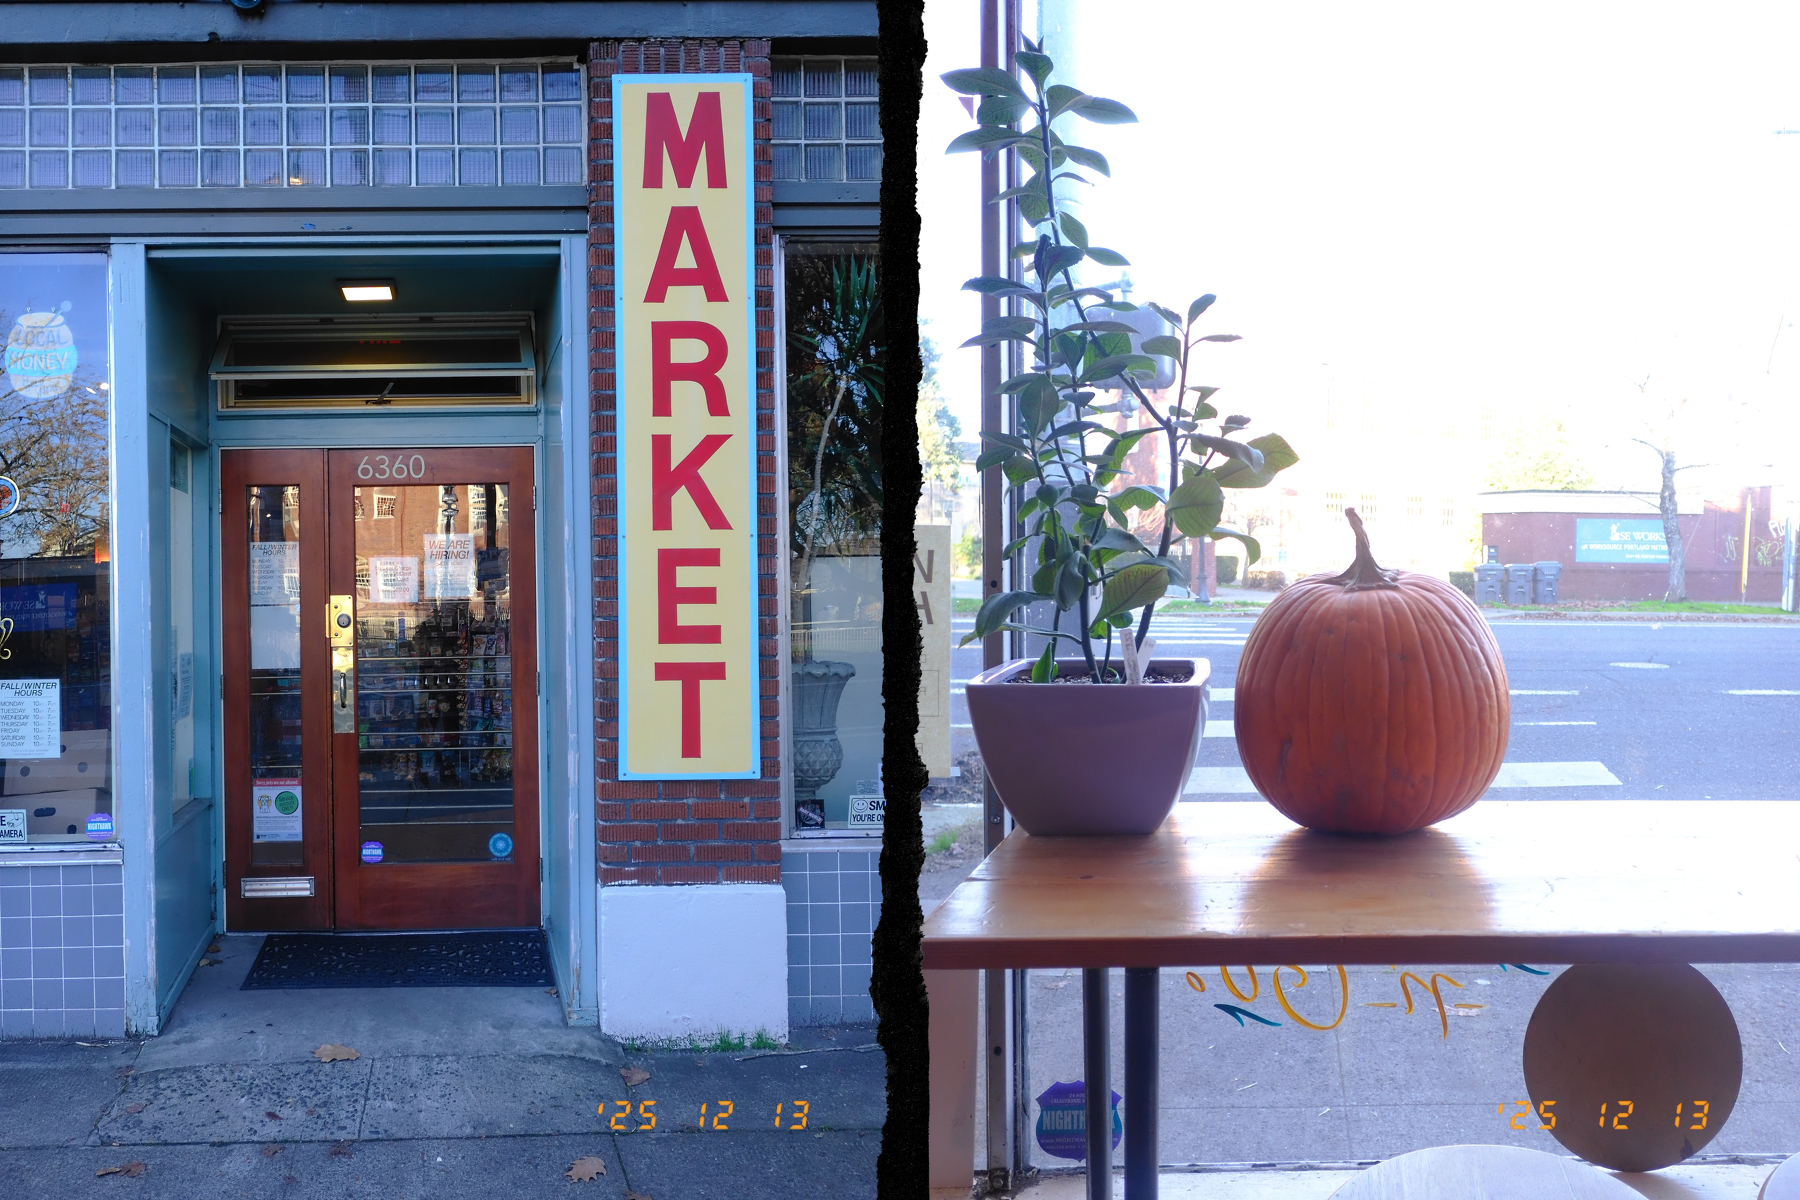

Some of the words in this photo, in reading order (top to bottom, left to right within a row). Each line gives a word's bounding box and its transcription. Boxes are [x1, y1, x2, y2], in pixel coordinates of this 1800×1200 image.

[10, 351, 68, 370] HONEY
[642, 92, 734, 758] MARKET
[358, 454, 425, 479] 6360
[429, 540, 446, 549] WE
[447, 540, 470, 549] ARE
[430, 550, 470, 559] HIRING!
[0, 682, 57, 690] FALL/WINTER
[852, 814, 875, 822] YOU'RE
[88, 822, 111, 830] NIGHTHAWK
